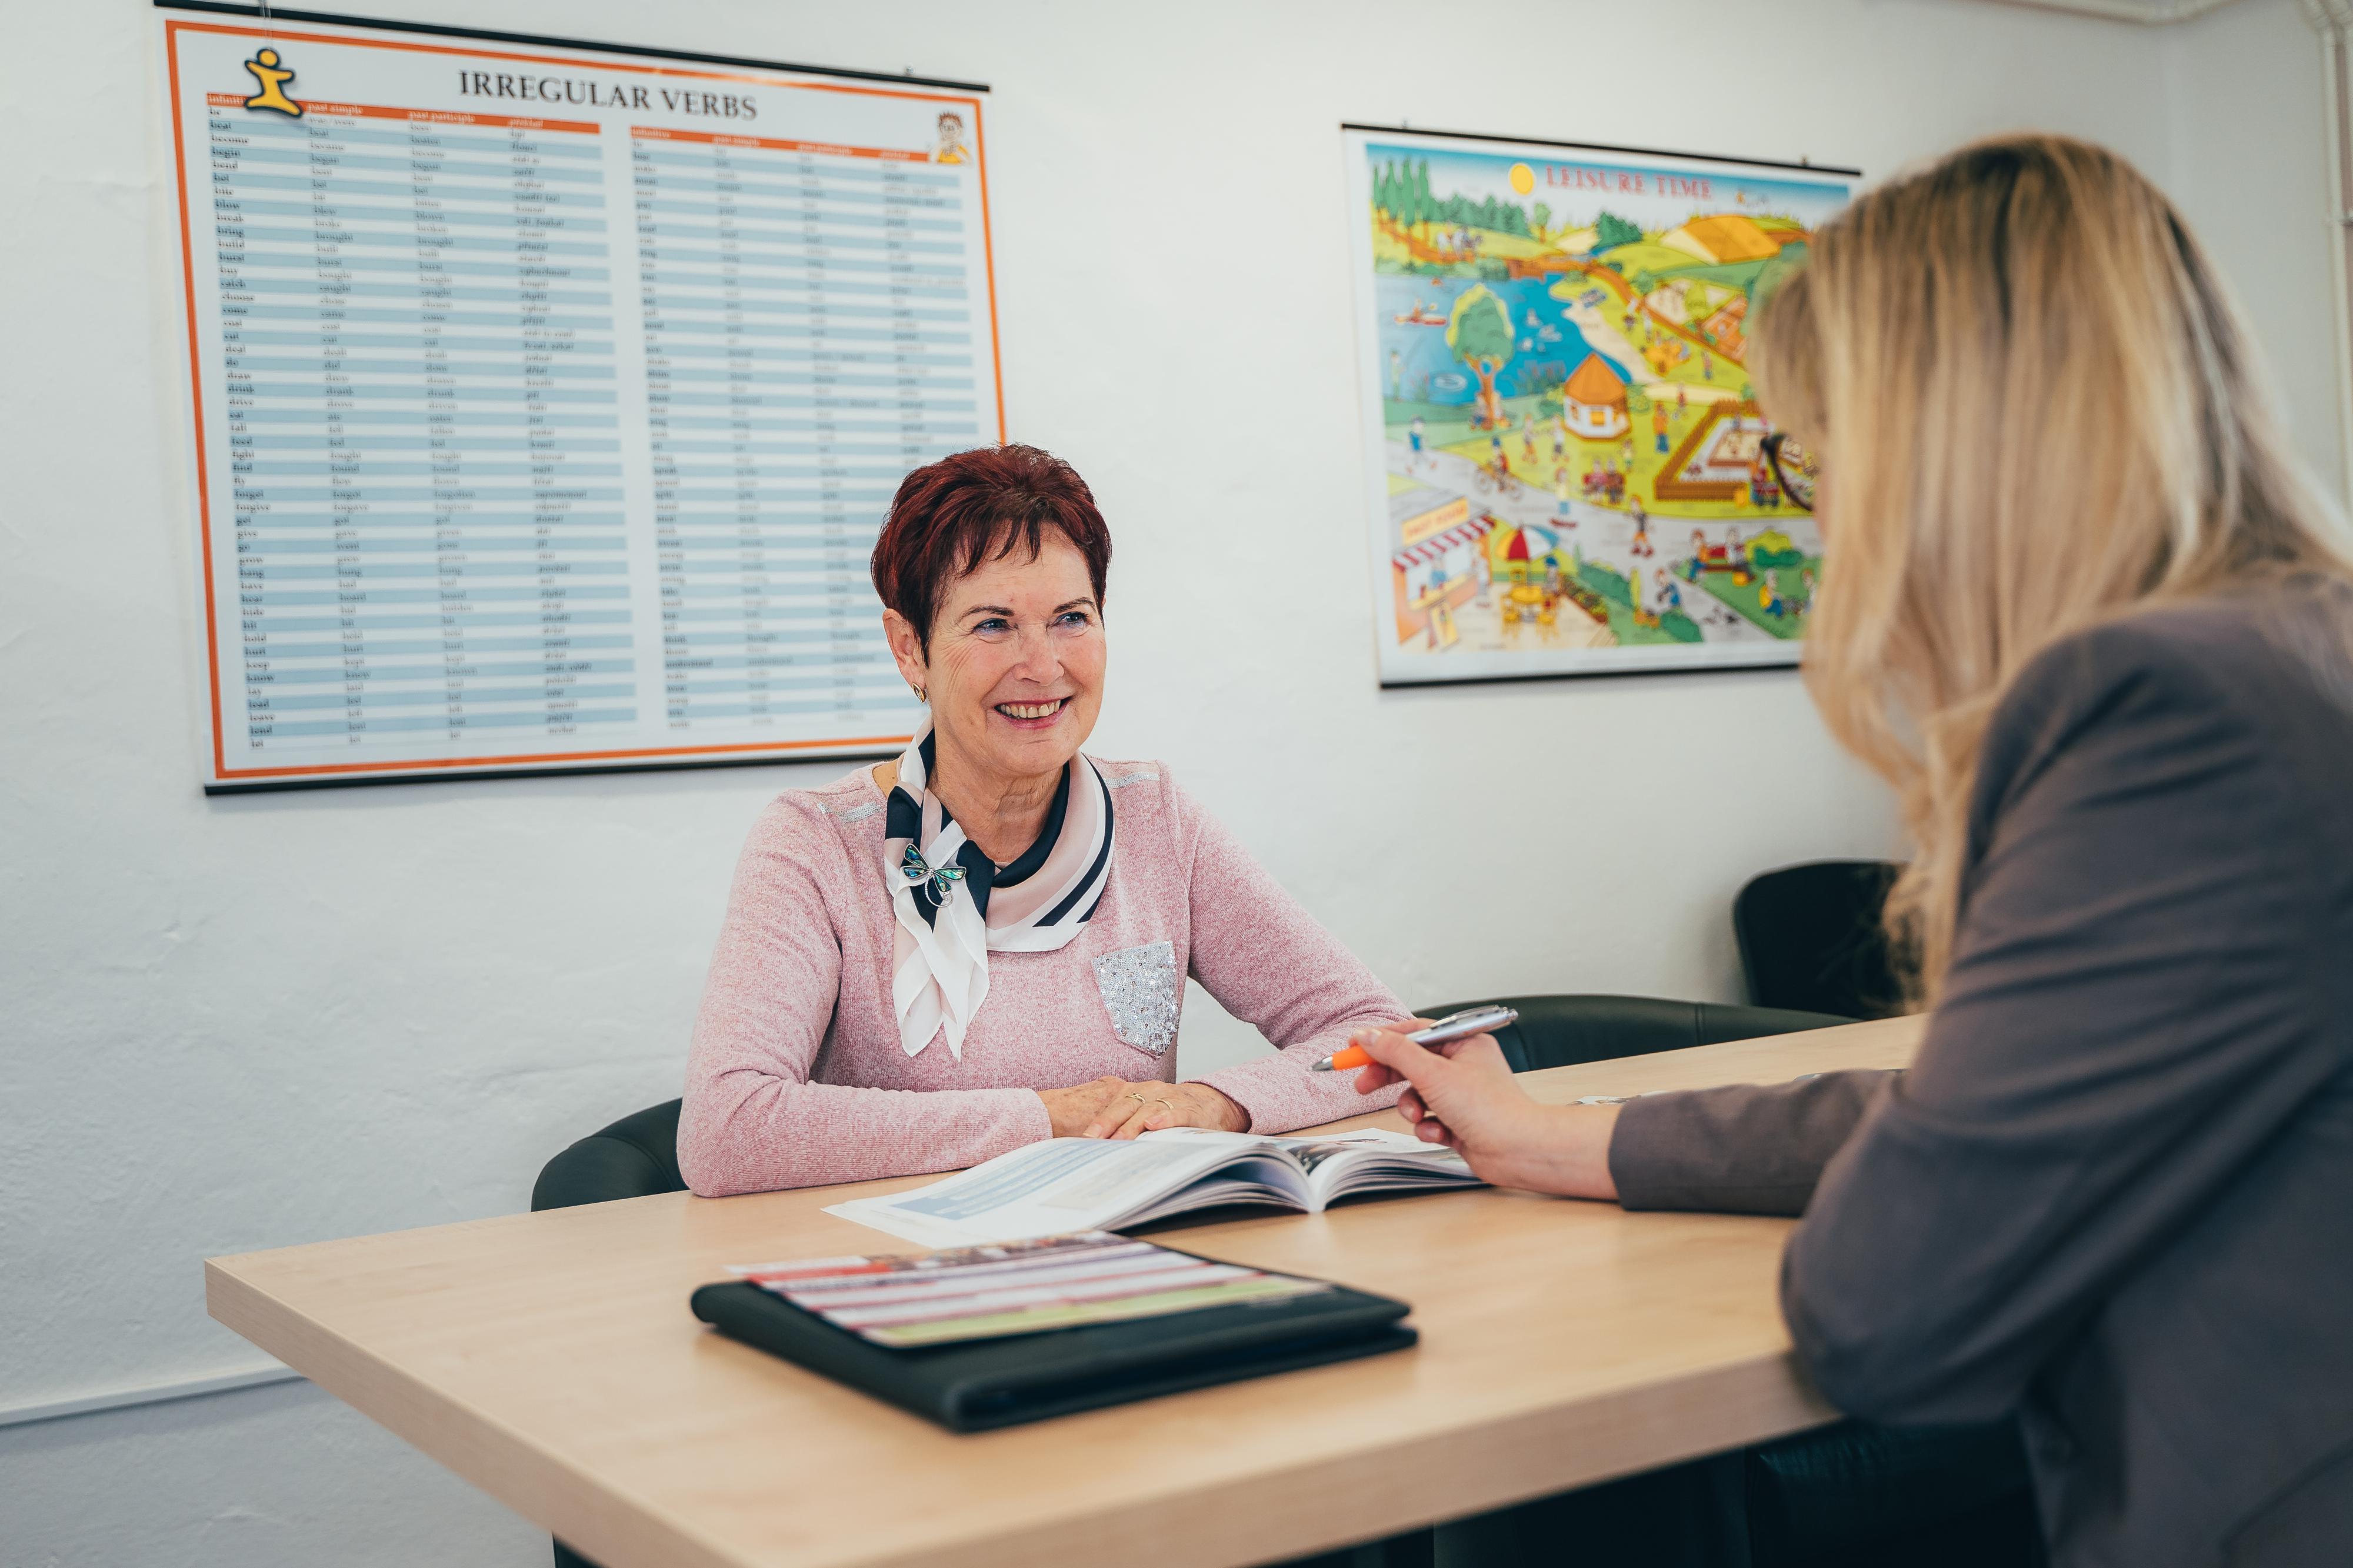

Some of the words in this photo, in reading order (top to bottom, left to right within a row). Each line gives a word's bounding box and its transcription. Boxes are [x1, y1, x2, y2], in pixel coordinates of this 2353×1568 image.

[458, 69, 651, 111] IRREGULAR
[659, 88, 757, 120] VERBS
[211, 146, 240, 160] begin
[1546, 165, 1646, 194] LEISURE
[1655, 175, 1713, 200] TIME
[216, 225, 244, 238] bring
[218, 251, 244, 262] burst
[221, 277, 245, 288] catch
[228, 382, 254, 392] drink
[234, 488, 264, 501] forget
